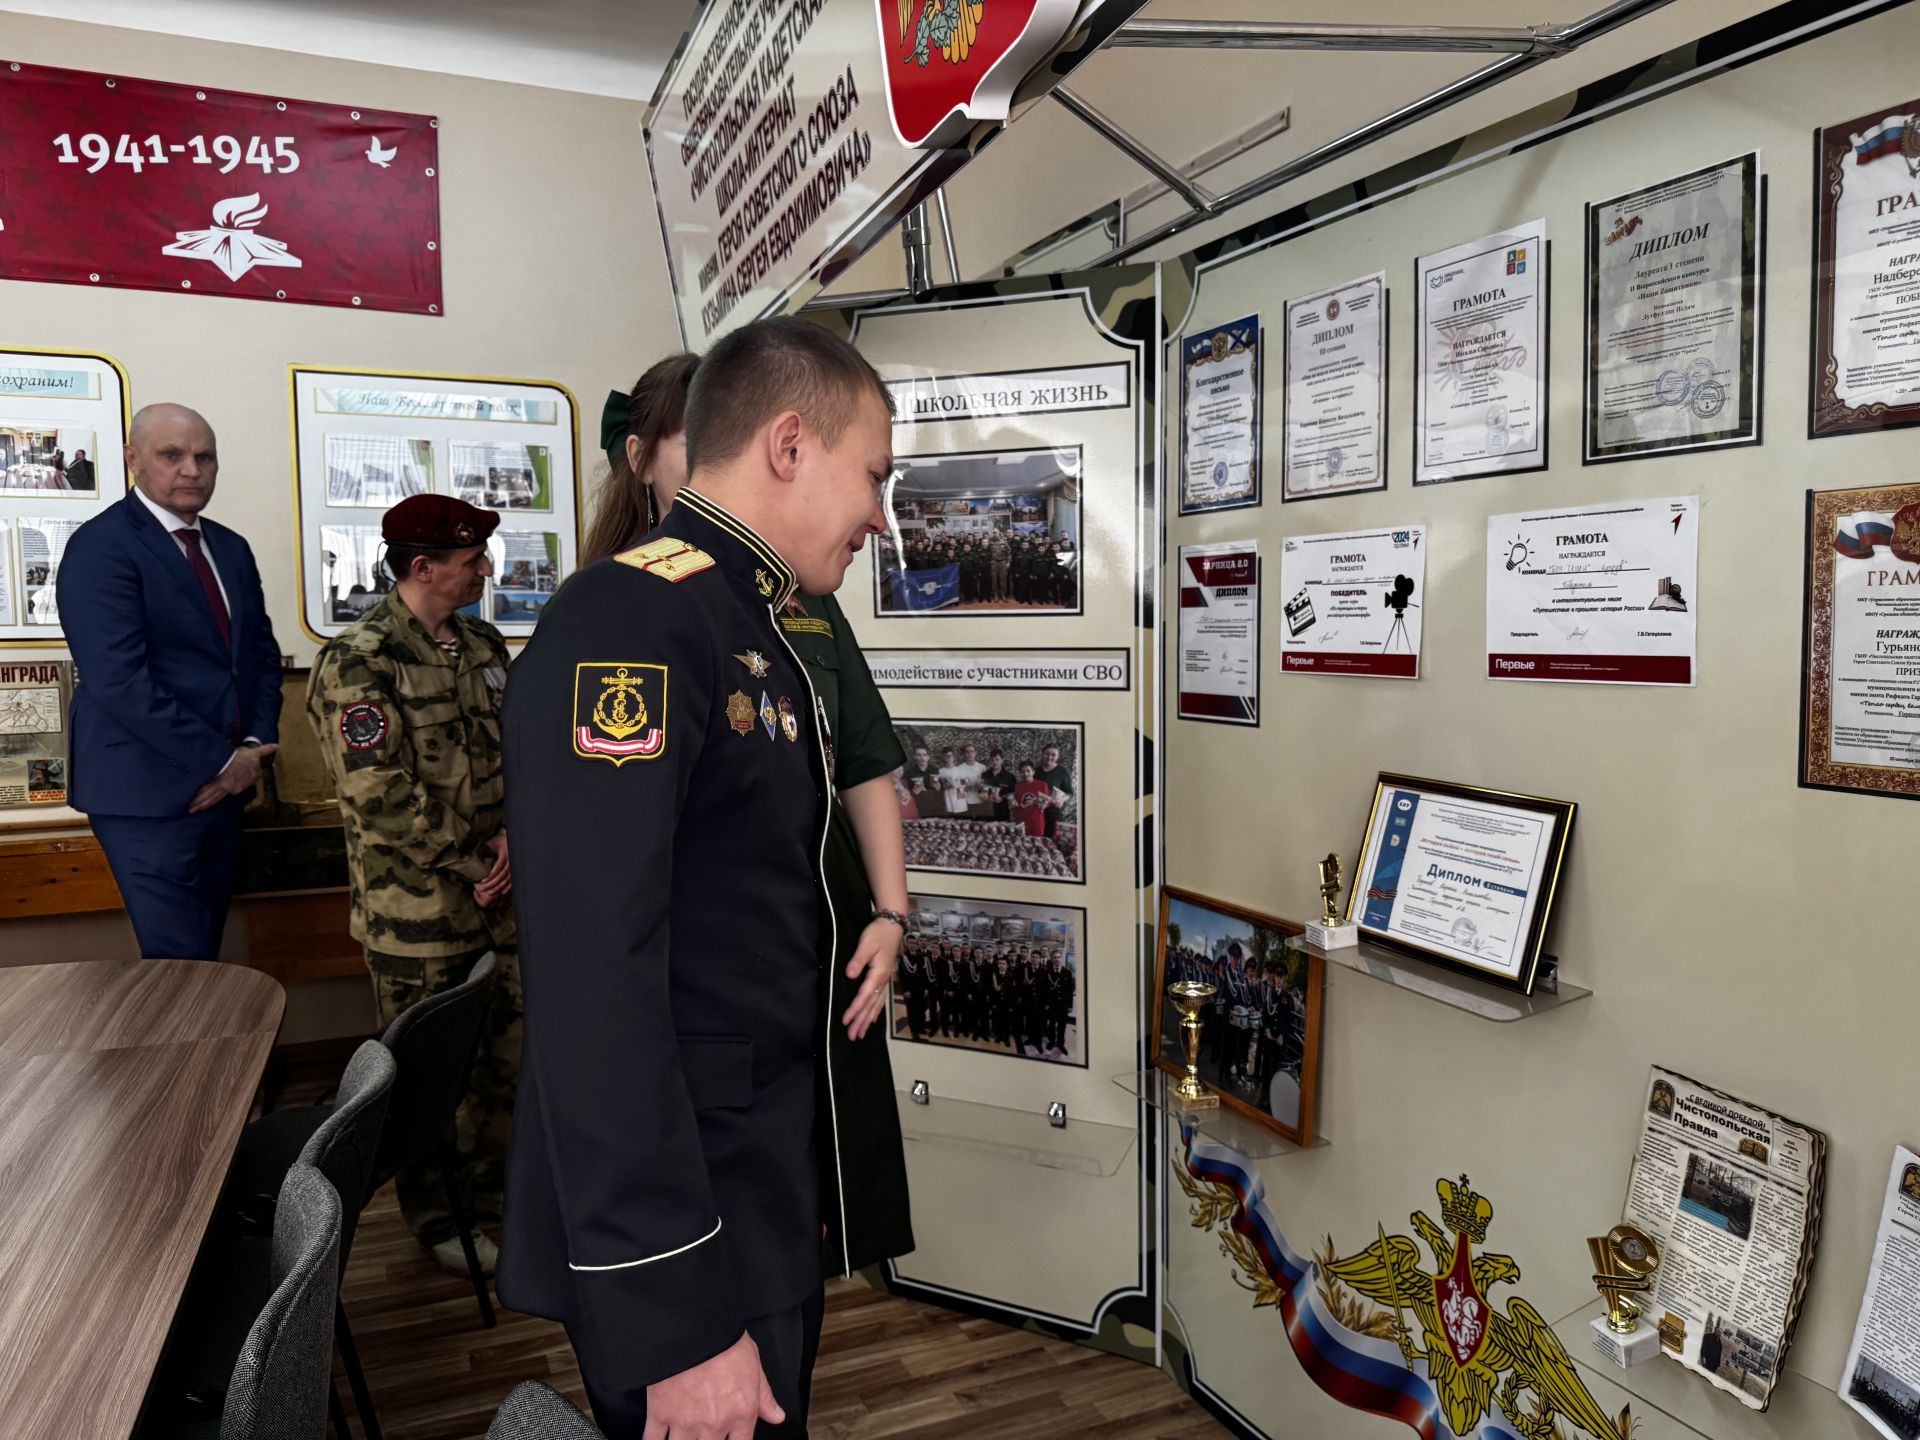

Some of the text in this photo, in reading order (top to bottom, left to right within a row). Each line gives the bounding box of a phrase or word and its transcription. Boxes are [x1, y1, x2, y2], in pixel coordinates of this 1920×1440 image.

[682, 0, 746, 120] ГОСУДАРСТВЕННОЕ
[681, 8, 762, 167] ОБЩЕОБРАЗОВАТЕЛЬНОЕ
[690, 0, 828, 202] «ЧИСТОПОЛЬСКАЯ КАДЕТСКА
[53, 133, 300, 174] 1941-1945
[715, 72, 797, 219] ШКОЛА-ИНТЕРНАТ
[698, 63, 860, 295] ИМЕНИ ГЕРОЯ СОВЕТСКОГО СОЮЗА
[1876, 190, 1920, 217] ГРА
[701, 128, 871, 337] КУЗЬМИНА СЕРГЕЯ ЕВДОКИМОВИЧА»
[1629, 222, 1711, 262] ДИПЛОМ
[1634, 263, 1668, 280] Лауреата
[1676, 255, 1705, 269] степени
[1636, 273, 1681, 291] Всероссийского
[1682, 267, 1710, 279] конкурса
[1453, 288, 1506, 312] ГРАМОТА
[1312, 323, 1354, 346] ДИПЛОМ
[1453, 330, 1506, 350] НАГРАЖДАЕТСЯ
[0, 375, 74, 390] охраним!
[1196, 369, 1244, 388] Благодарственное
[1210, 384, 1231, 395] письмо
[1031, 384, 1108, 406] жизнь
[1556, 533, 1609, 546] ГРАМОТА
[1330, 553, 1366, 564] ГРАМОТА
[1559, 550, 1606, 559] НАГРАЖДАЕТСЯ
[1215, 587, 1248, 598] ДИПЛОМ
[1330, 589, 1368, 597] ПОБЕДИТЕЛЬ
[1876, 629, 1920, 640] НАГРАЖ
[1286, 656, 1315, 667] Первые
[1496, 658, 1535, 671] Первые
[0, 665, 60, 684] НГРАДА
[967, 668, 975, 681] с
[977, 667, 1078, 682] участниками
[1083, 665, 1123, 682] СВО
[1427, 863, 1482, 888] Диплом
[1676, 1097, 1771, 1144] Чистопольская
[1694, 1095, 1728, 1114] ВЕЛИКОЙ
[1728, 1109, 1767, 1130] ПОБЕДОЙ!
[1674, 1112, 1718, 1139] Правда
